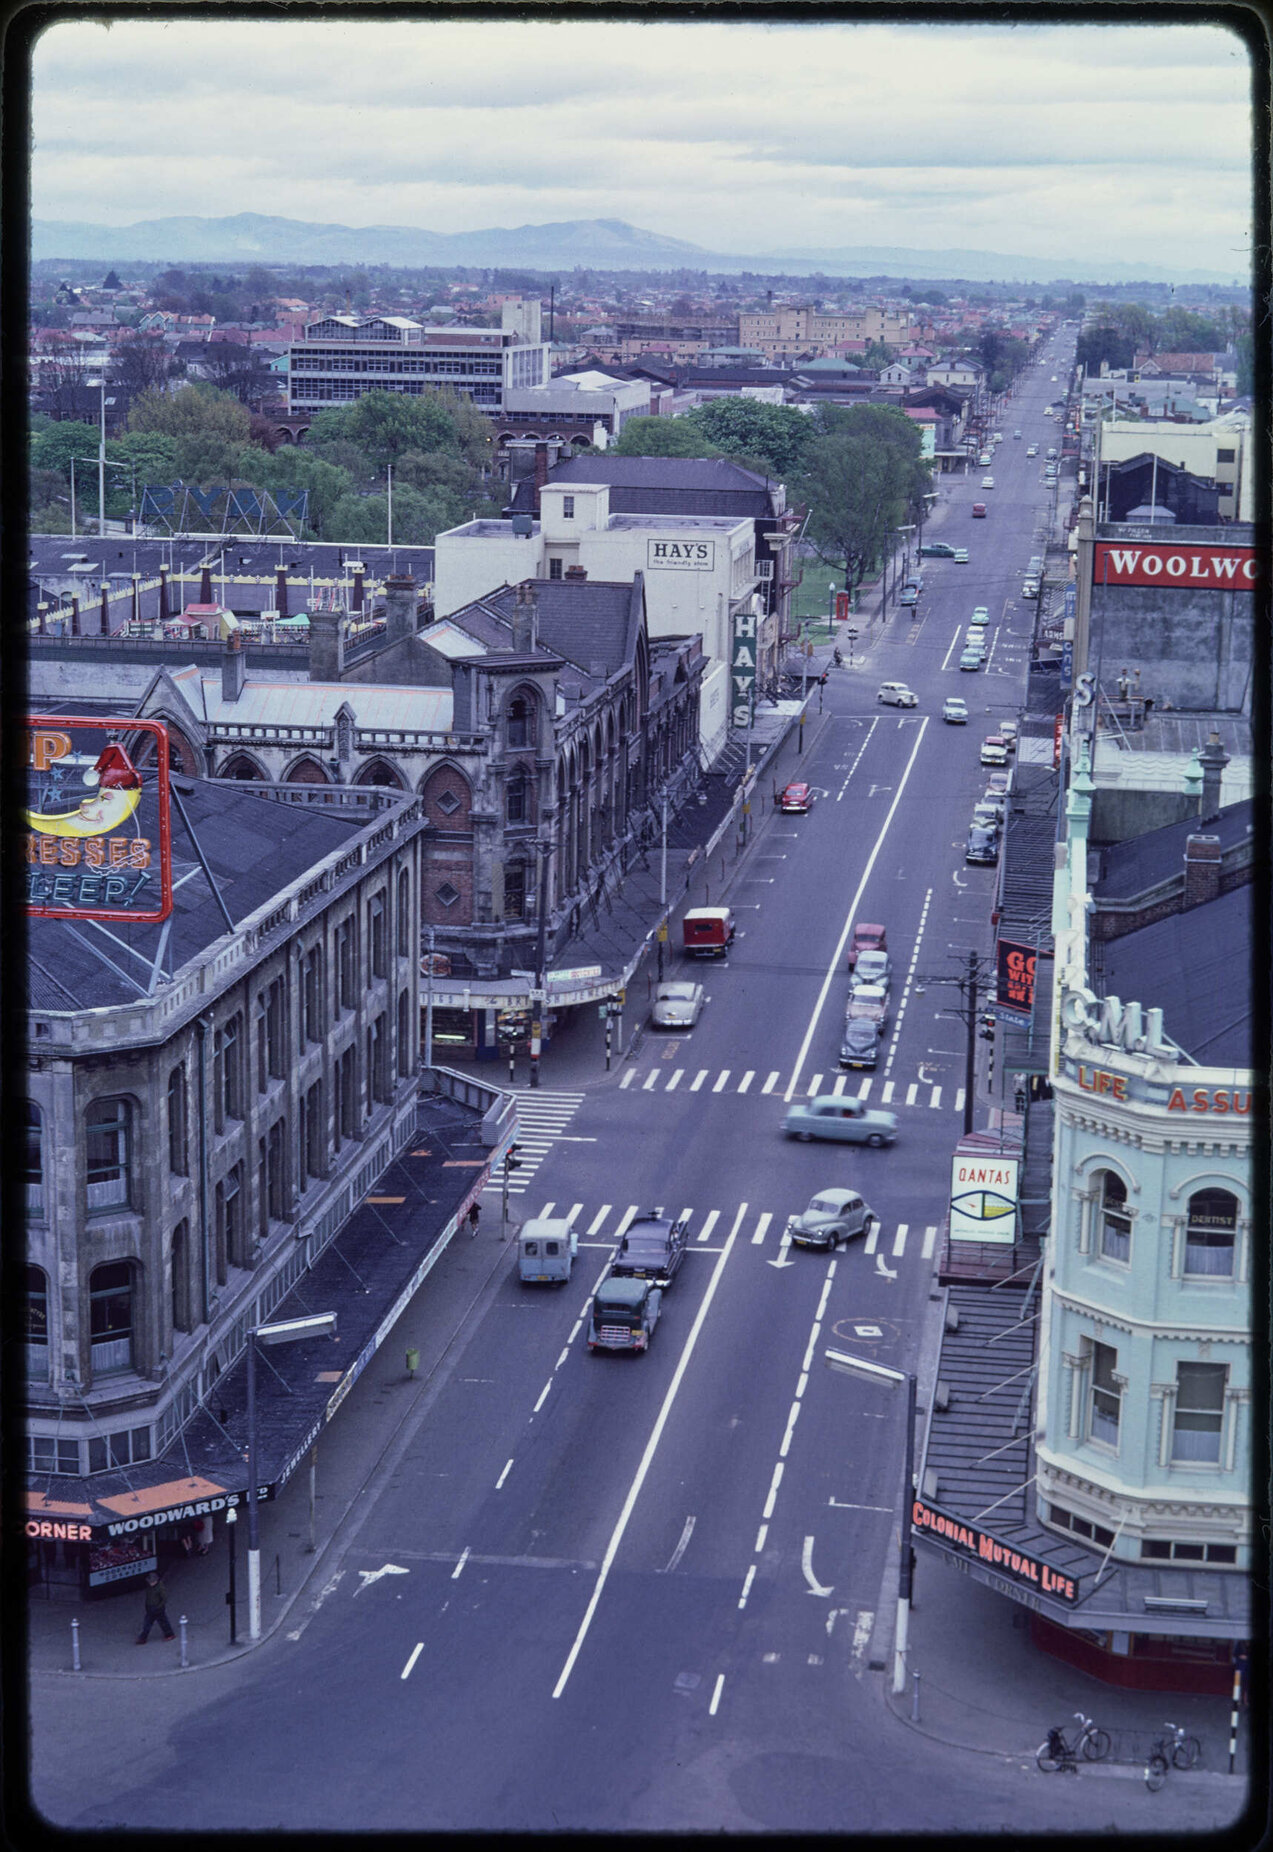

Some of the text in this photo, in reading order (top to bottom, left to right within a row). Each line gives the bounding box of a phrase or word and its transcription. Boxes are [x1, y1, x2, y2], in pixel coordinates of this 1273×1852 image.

[654, 543, 708, 558] HAY'S
[1008, 968, 1034, 985] WIT
[1078, 1065, 1129, 1100] LIFE
[958, 1167, 1010, 1185] QANTAS
[107, 1493, 241, 1537] WOODWARD'S
